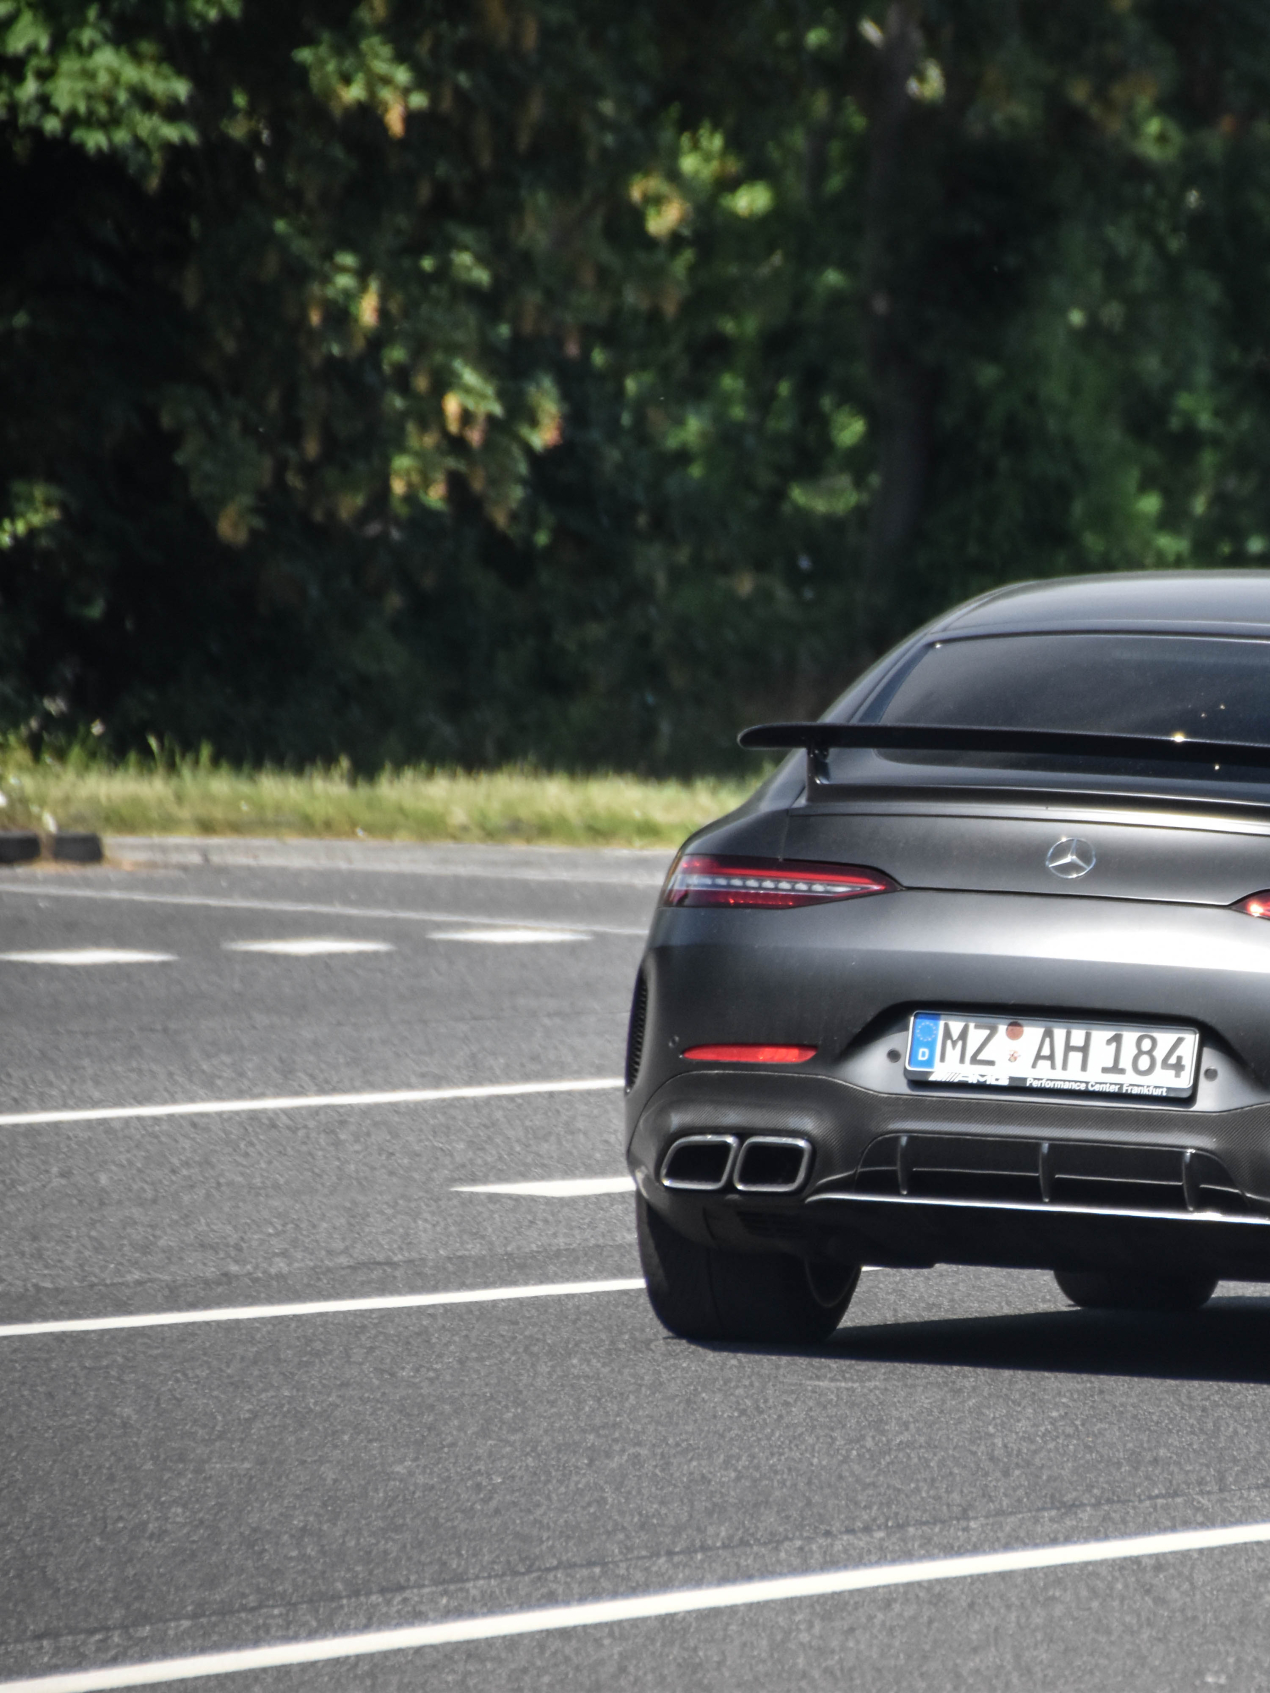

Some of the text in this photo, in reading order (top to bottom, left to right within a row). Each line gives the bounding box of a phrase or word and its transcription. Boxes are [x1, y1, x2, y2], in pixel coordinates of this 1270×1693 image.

[917, 1048, 930, 1061] D
[939, 1021, 1186, 1079] MZ AH 184
[1026, 1077, 1086, 1091] Performance
[1088, 1082, 1119, 1093] Center
[1122, 1085, 1167, 1096] Frankfurt
